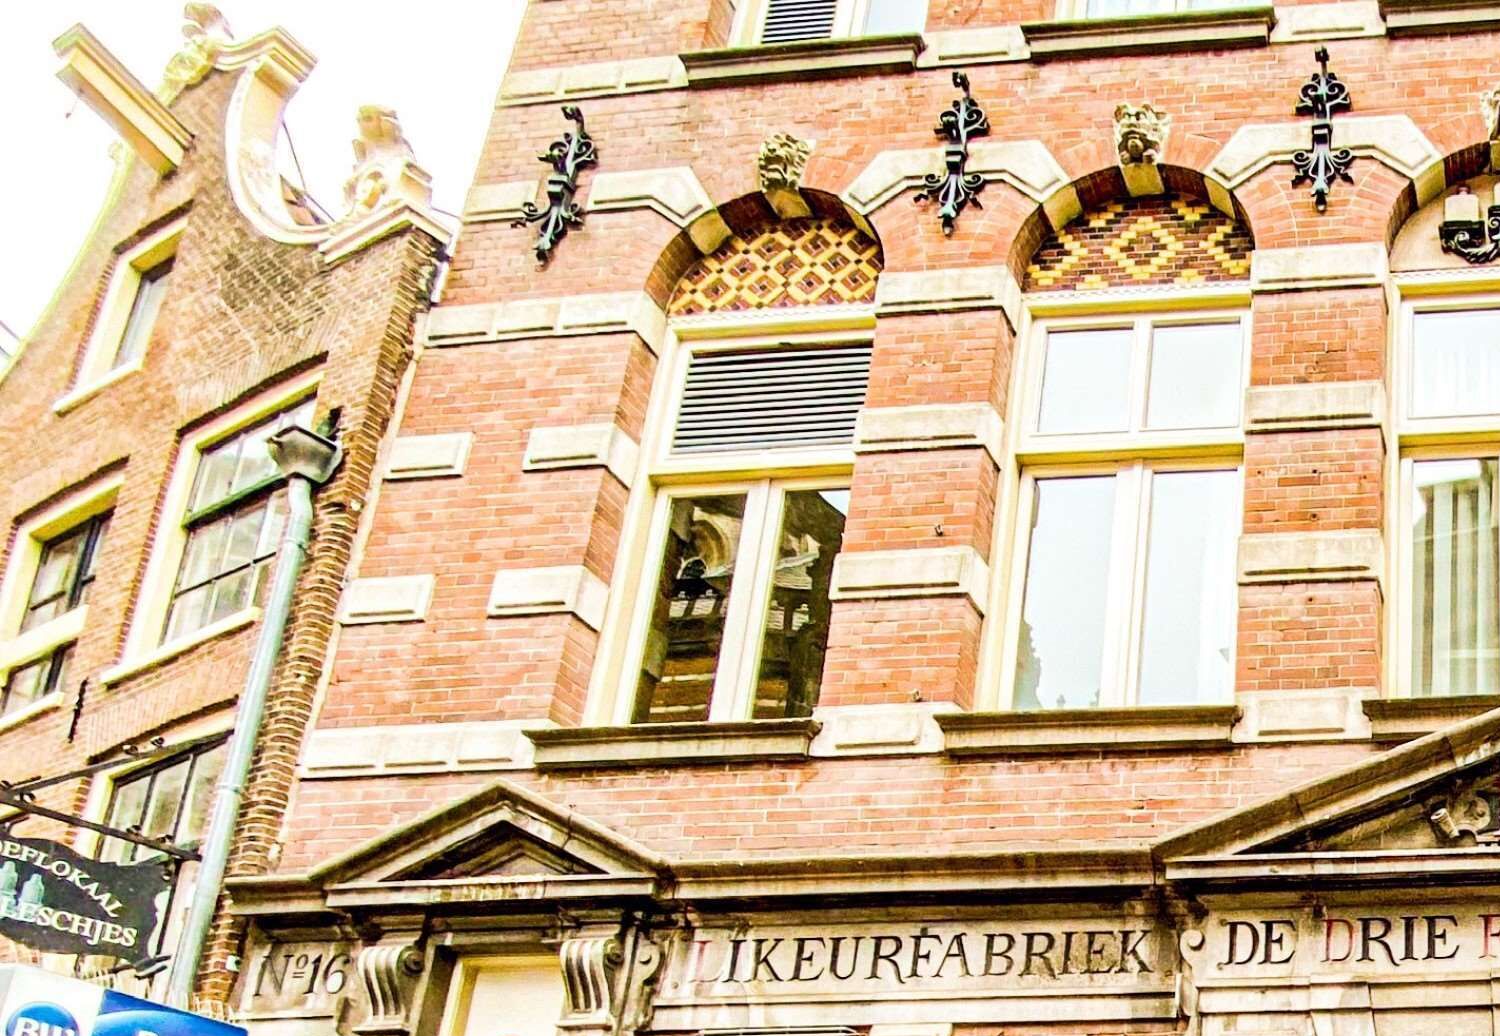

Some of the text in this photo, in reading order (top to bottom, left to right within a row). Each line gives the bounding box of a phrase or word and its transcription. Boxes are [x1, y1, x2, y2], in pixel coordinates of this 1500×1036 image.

[0, 840, 124, 918] EFLOKAAL
[688, 927, 1156, 985] LIKEURFABRIEK
[1222, 919, 1296, 966] DE
[1321, 914, 1460, 967] DRIE
